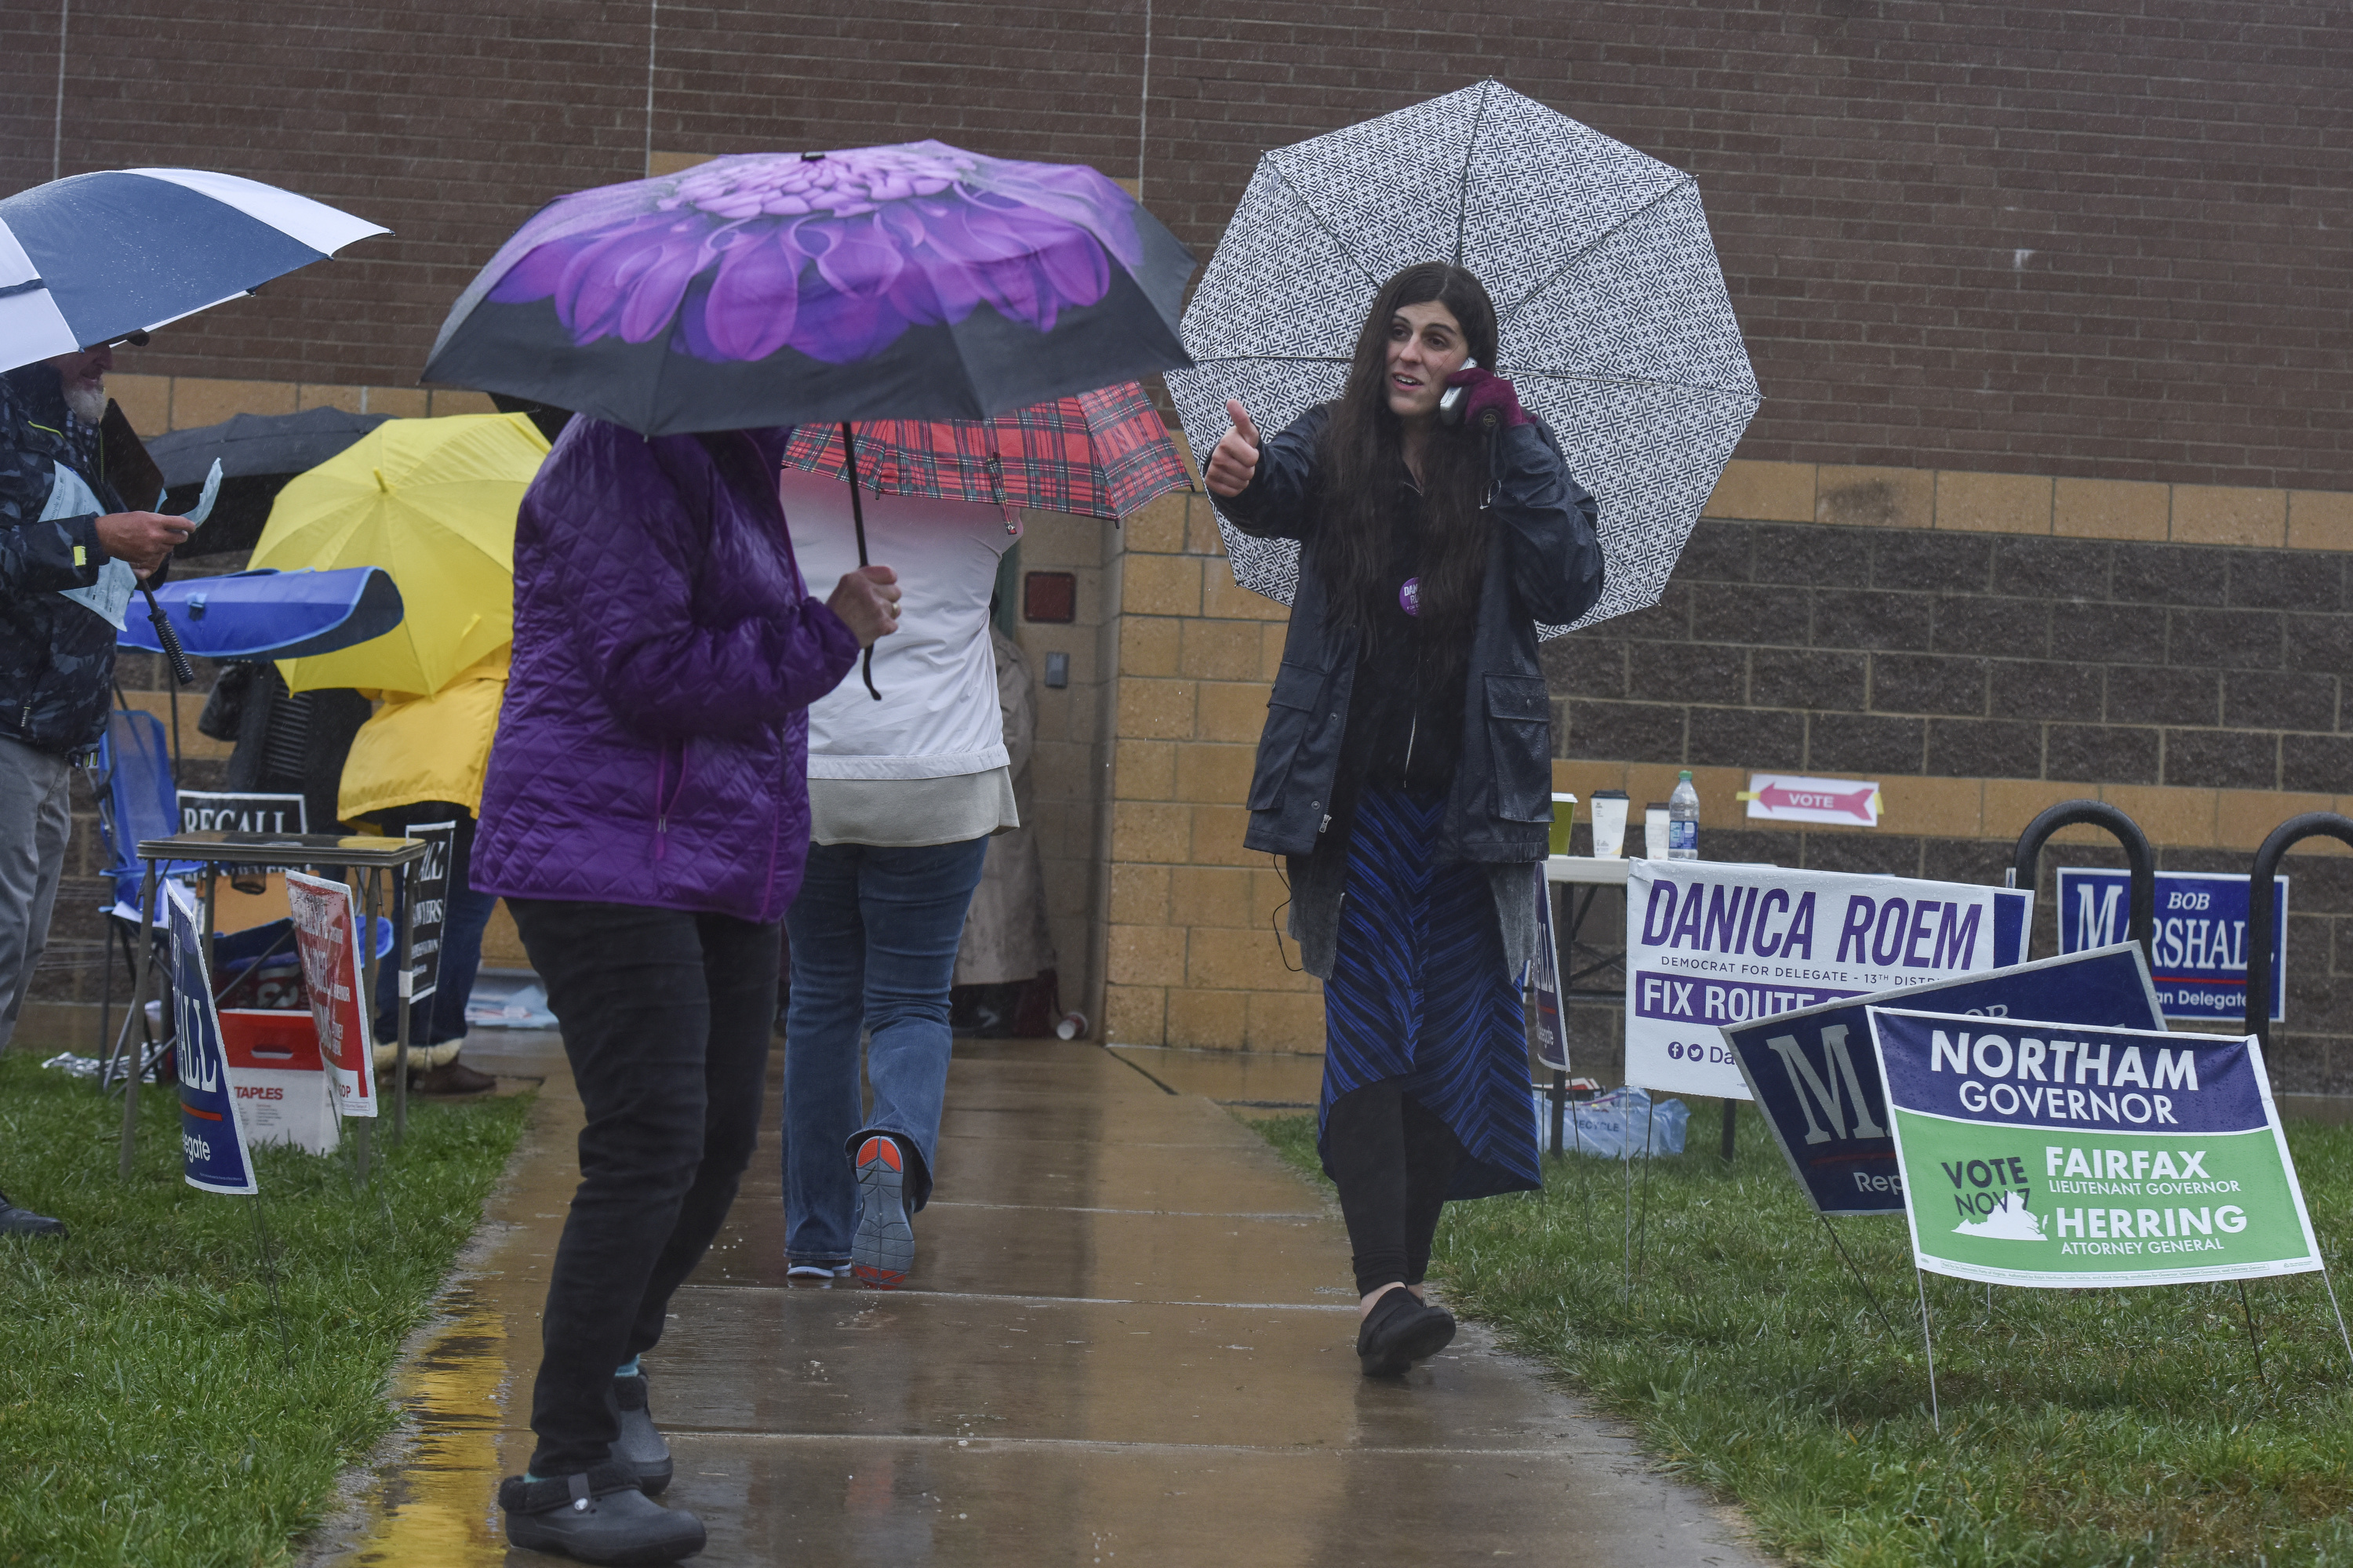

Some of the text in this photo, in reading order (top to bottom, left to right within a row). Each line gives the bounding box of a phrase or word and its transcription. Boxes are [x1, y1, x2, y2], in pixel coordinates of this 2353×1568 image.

[1789, 793, 1834, 808] VOTE
[2167, 892, 2210, 910] BOB
[1642, 879, 1982, 970] DANICA ROEM
[1661, 956, 1736, 973] DEMOCRAT
[1741, 965, 1769, 976] FOR
[1775, 968, 1848, 981] DELEGATE
[1644, 978, 1694, 1017] FIX
[2178, 990, 2246, 1010] Delegate
[1931, 1030, 2198, 1090] NORTHAM
[235, 1086, 283, 1100] TAPLES
[1959, 1080, 2178, 1124] GOVERNOR
[1941, 1156, 2028, 1189] VOTE
[2046, 1146, 2211, 1180] FAIRFAX
[1955, 1188, 2031, 1217] NOV 7
[2049, 1180, 2242, 1196] LIEUTENANT GOVERNOR
[2057, 1205, 2248, 1239] HERRING
[2061, 1238, 2224, 1255] ATTORNEY GENERAL
